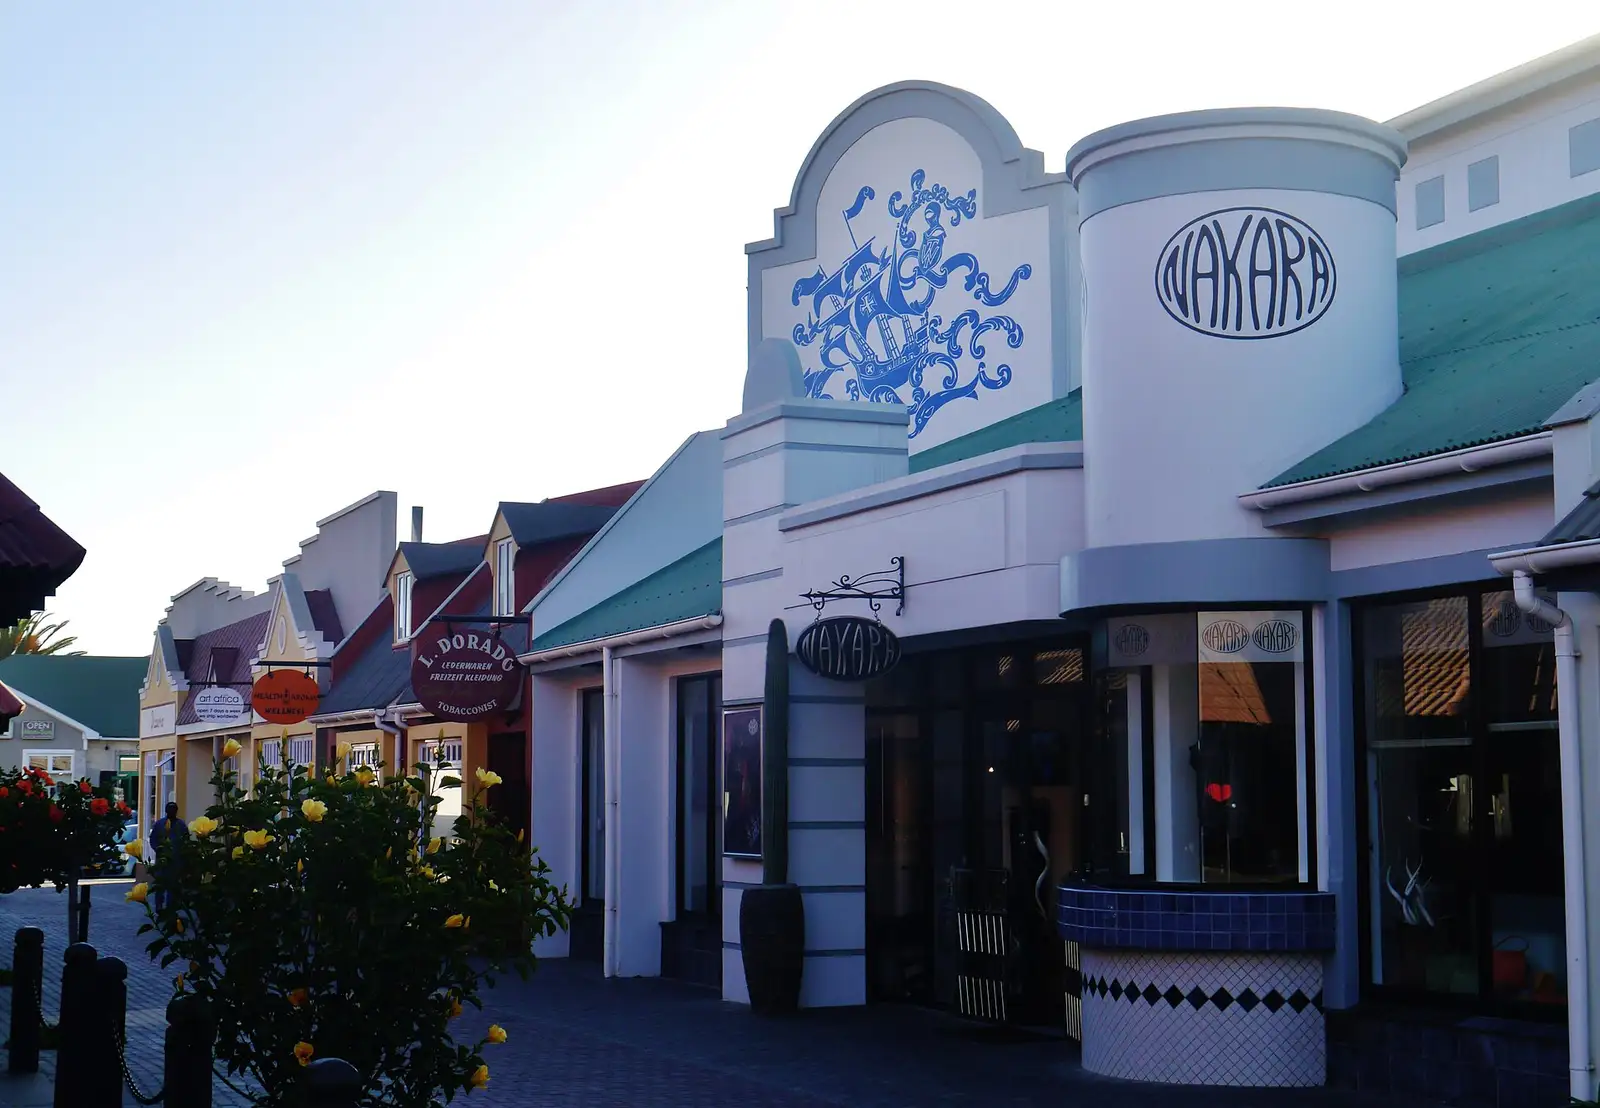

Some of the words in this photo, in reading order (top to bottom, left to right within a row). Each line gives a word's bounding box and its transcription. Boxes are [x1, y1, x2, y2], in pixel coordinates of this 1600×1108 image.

[1163, 213, 1329, 331] NAKARA
[1204, 620, 1249, 651] NAKARA
[801, 622, 895, 676] NAKARA
[441, 661, 493, 671] LEDERWAREN
[429, 673, 465, 681] FREIZEIT
[464, 673, 503, 682] KLEIDUNG
[199, 694, 211, 703] art
[213, 694, 239, 703] africa
[437, 698, 498, 715] TOBACCONIST
[26, 722, 50, 730] OPEN
